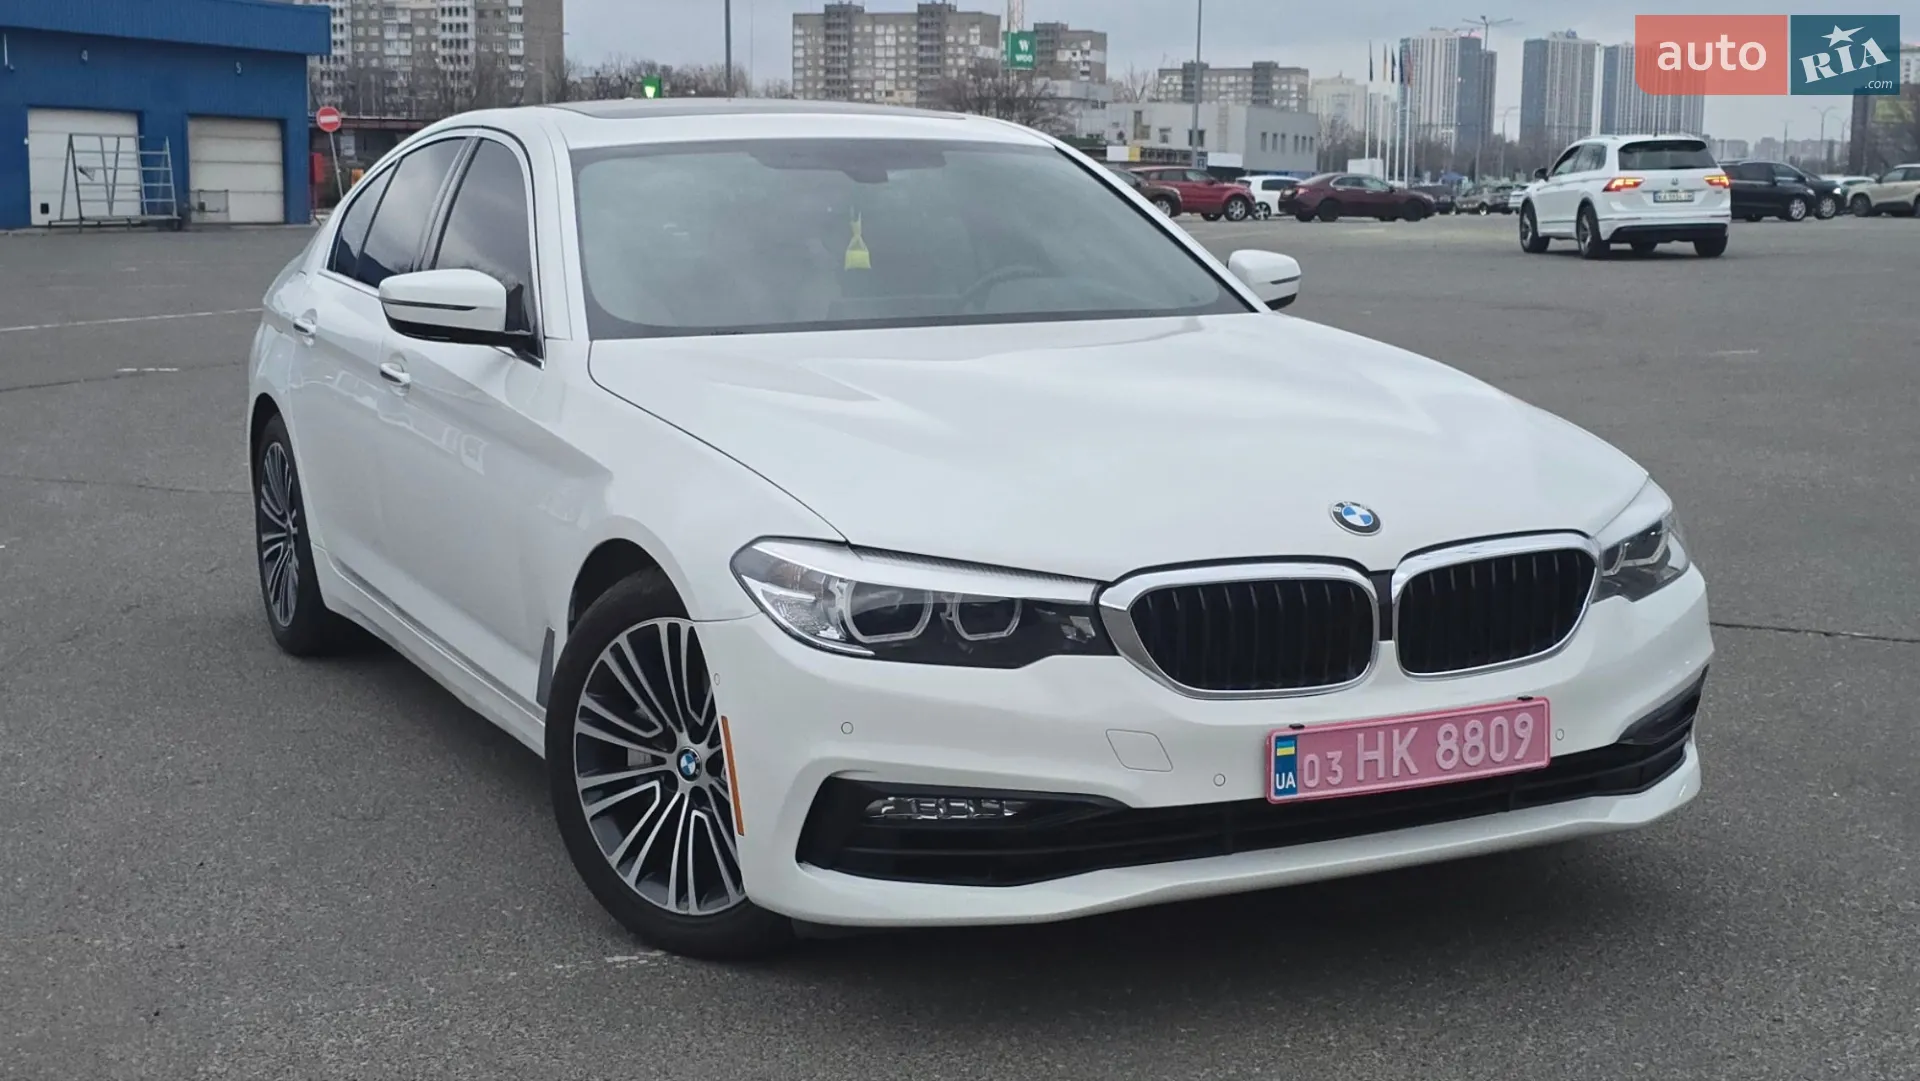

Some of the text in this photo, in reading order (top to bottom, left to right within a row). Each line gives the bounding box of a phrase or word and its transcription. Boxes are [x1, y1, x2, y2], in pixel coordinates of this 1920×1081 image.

[1303, 712, 1534, 788] 03 HK 8809
[1275, 771, 1297, 790] UA
